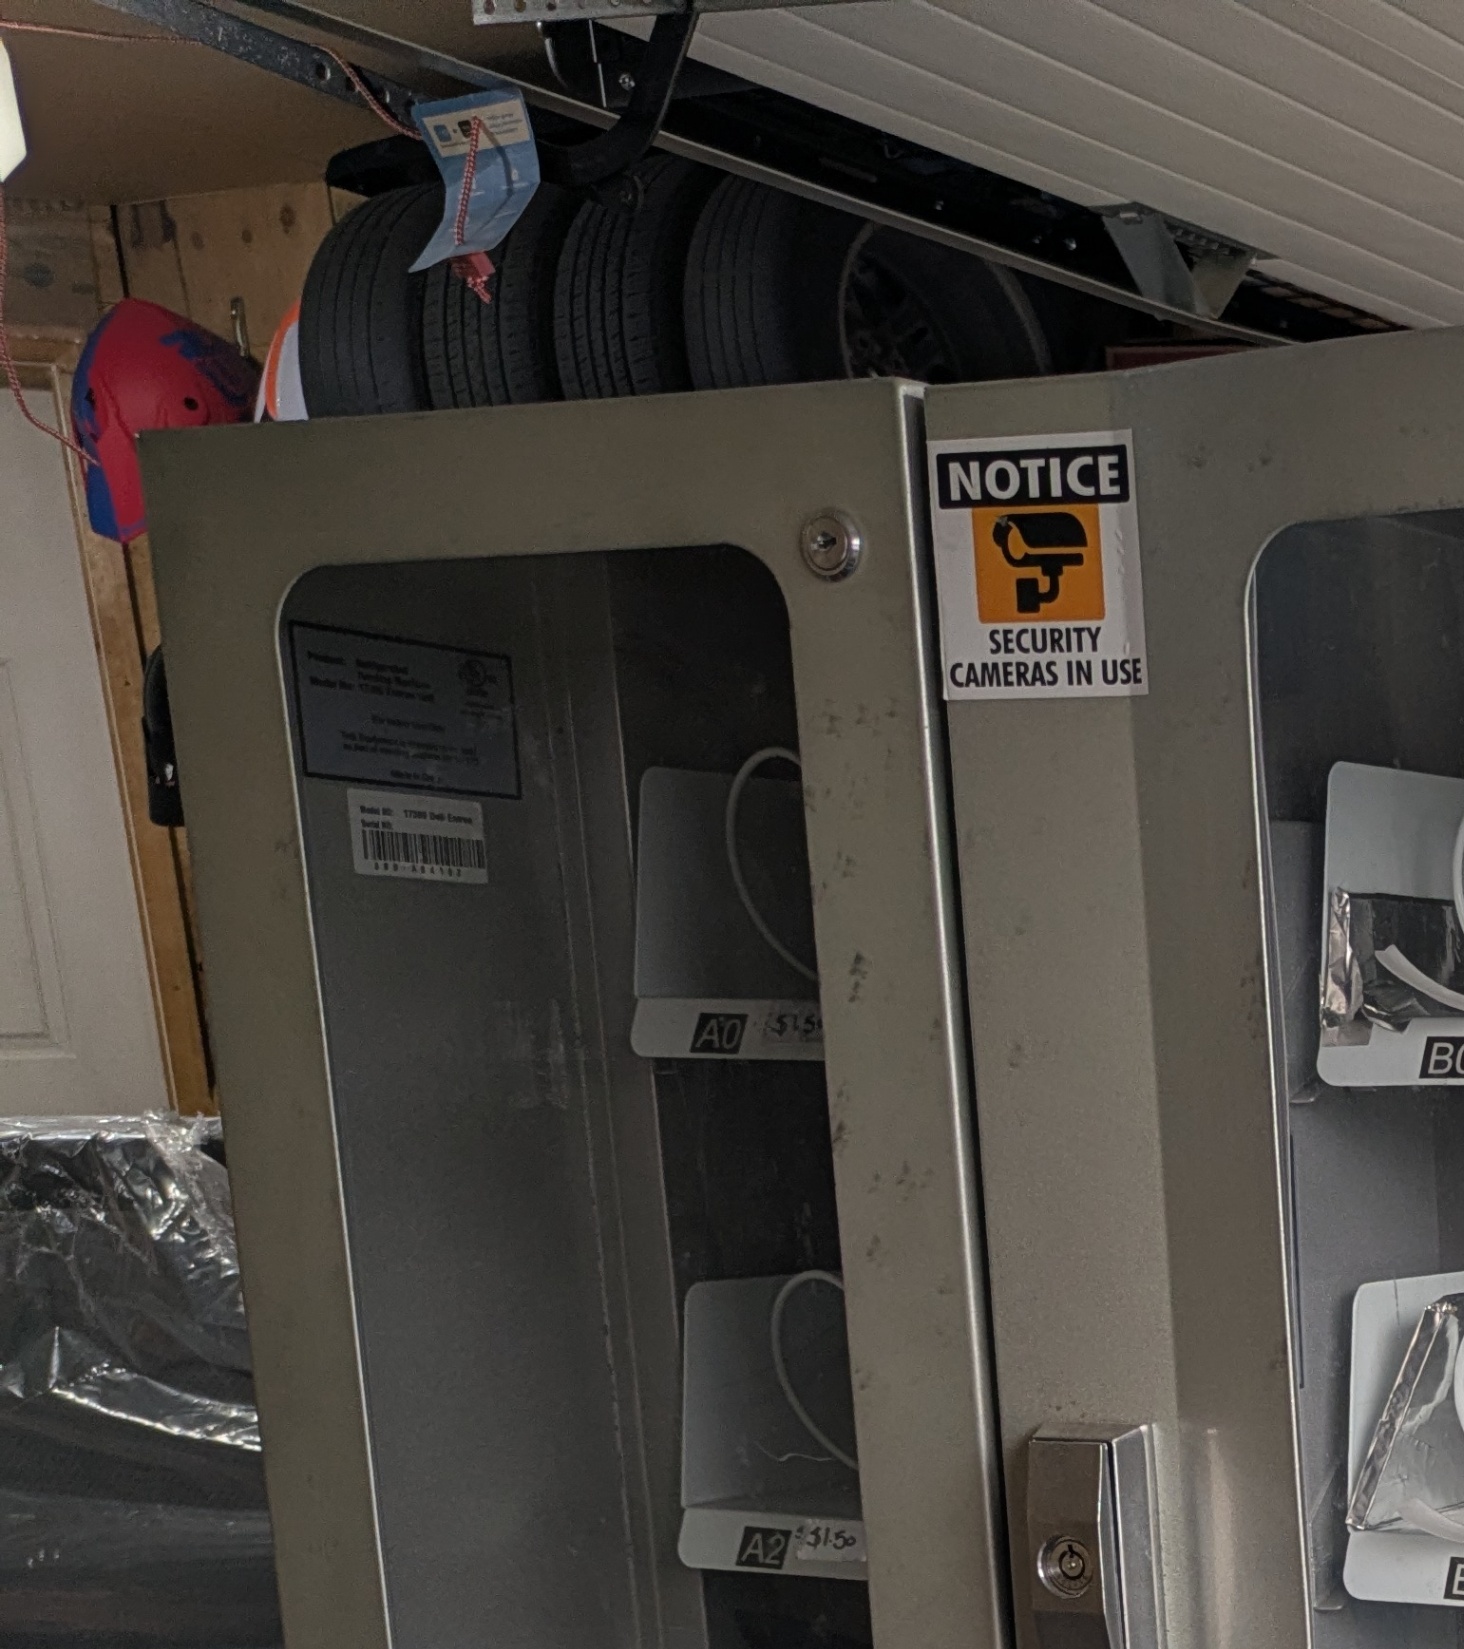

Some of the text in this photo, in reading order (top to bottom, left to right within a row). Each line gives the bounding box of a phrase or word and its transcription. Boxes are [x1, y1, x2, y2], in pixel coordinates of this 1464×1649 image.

[949, 455, 1121, 501] NOTICE
[989, 627, 1101, 654] SECURITY
[950, 658, 1142, 688] CAMERAS IN USE
[695, 1018, 741, 1050] A0
[741, 1532, 786, 1565] A2
